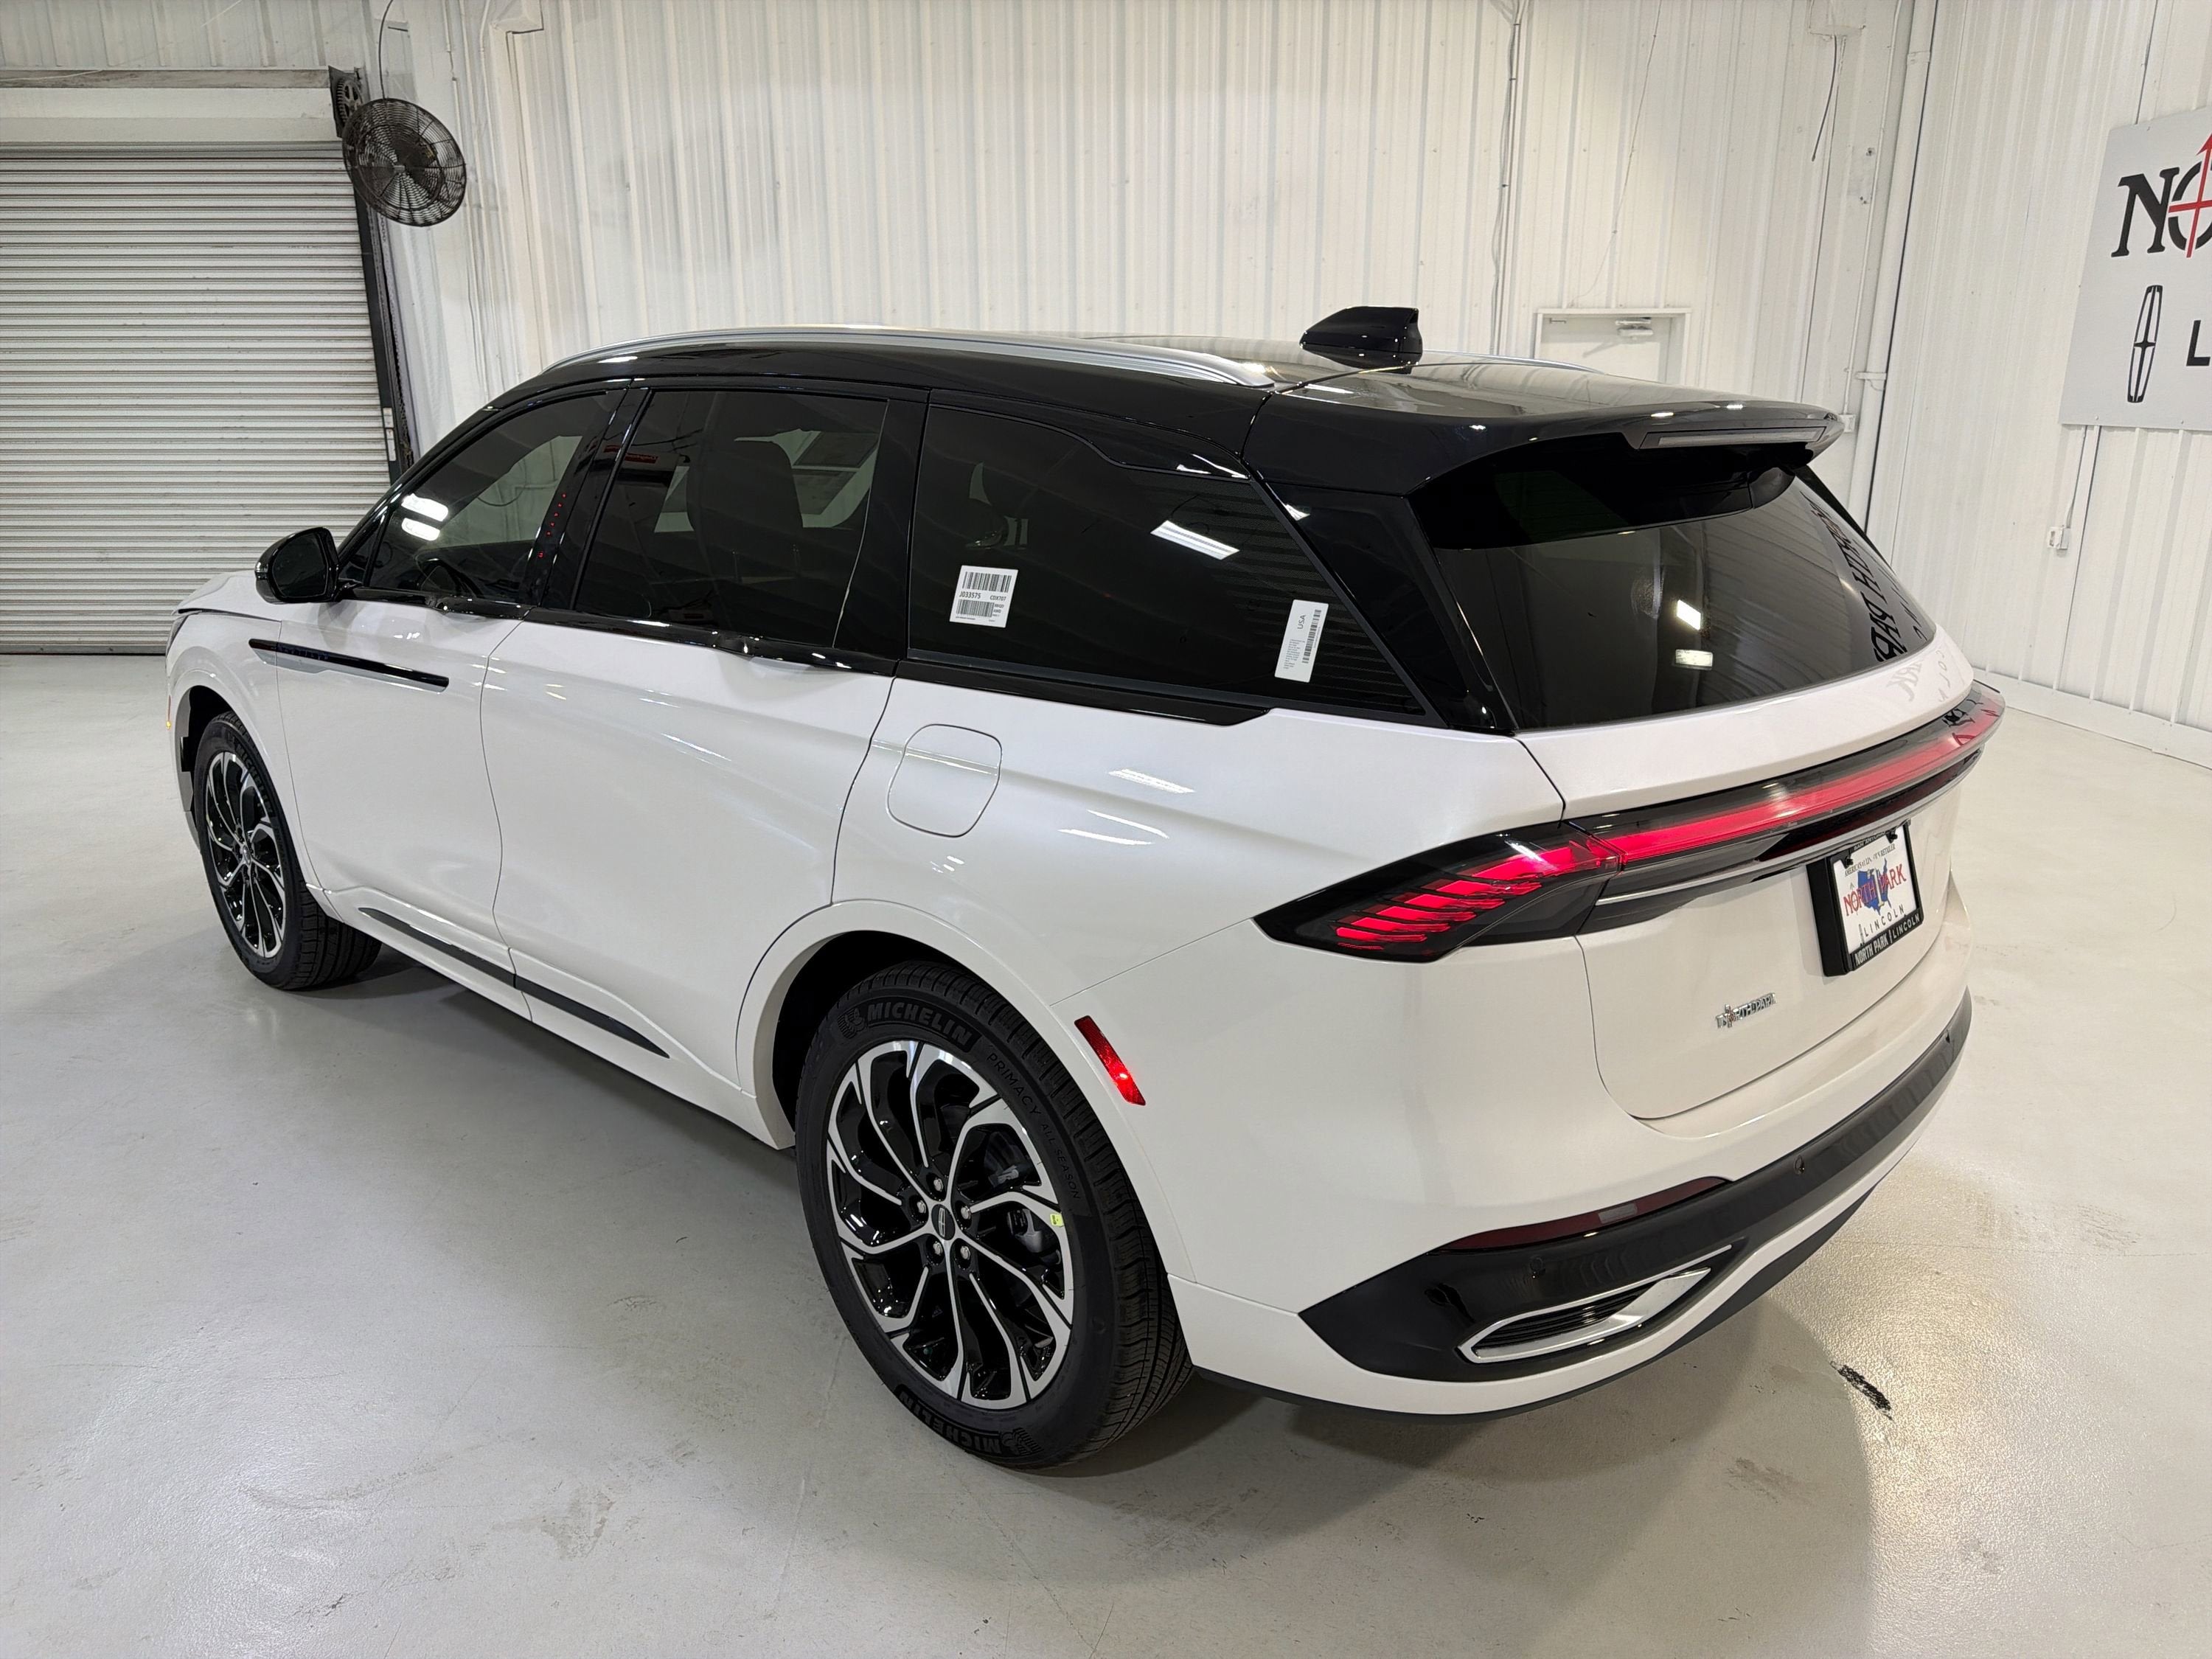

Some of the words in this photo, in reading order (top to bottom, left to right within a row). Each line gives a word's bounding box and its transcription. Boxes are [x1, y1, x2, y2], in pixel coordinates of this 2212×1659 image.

[959, 591, 981, 599] J033575
[1297, 614, 1307, 630] USA
[1843, 879, 1877, 917] NORTH
[1879, 863, 1907, 894] PARK
[1854, 945, 1874, 966] NORTH
[1874, 933, 1889, 953] PARK
[1892, 913, 1920, 939] LINCOLN
[1863, 904, 1905, 937] LINCOLN
[867, 1002, 972, 1046] MICHELIN
[987, 1052, 1041, 1115] PRIMACY
[1040, 1123, 1057, 1144] ALL
[1055, 1149, 1081, 1200] SEASON
[898, 1391, 1001, 1454] MICHELIN
